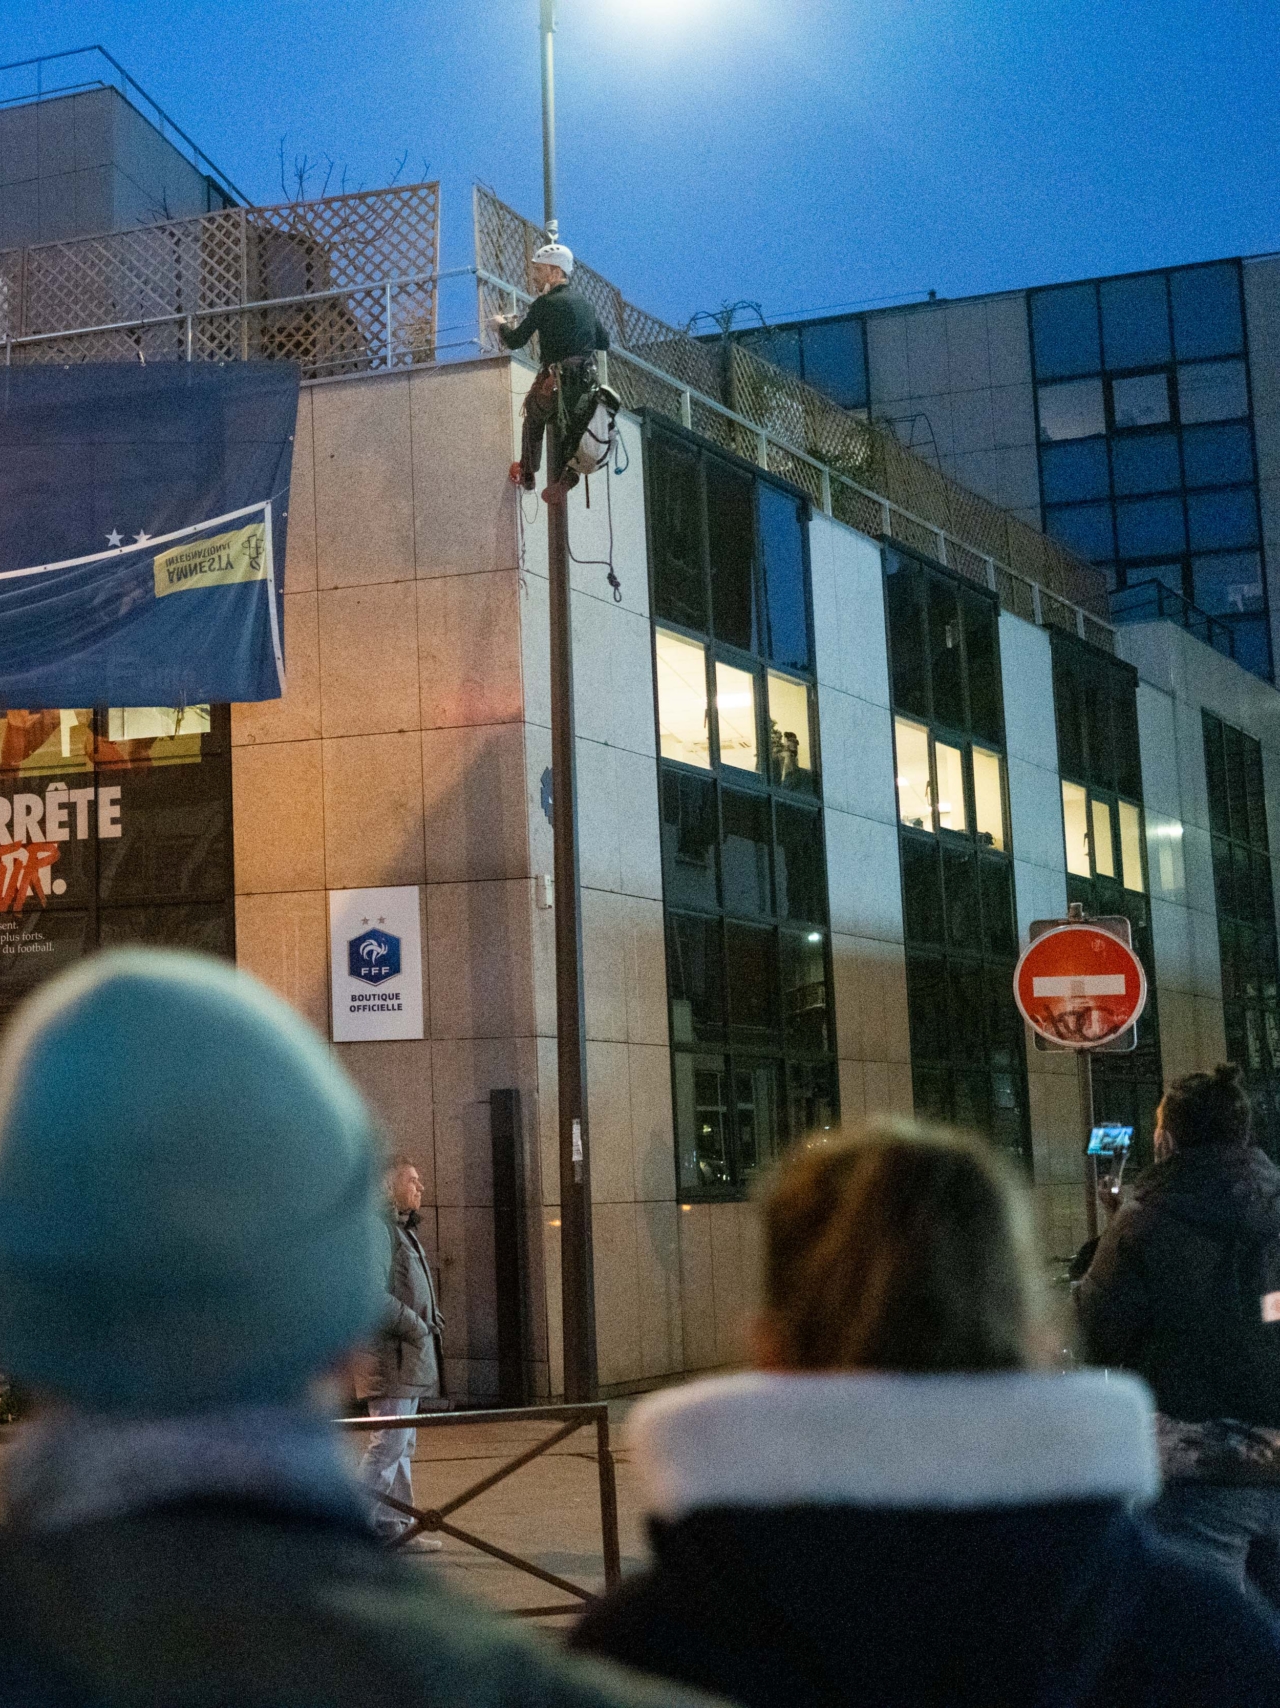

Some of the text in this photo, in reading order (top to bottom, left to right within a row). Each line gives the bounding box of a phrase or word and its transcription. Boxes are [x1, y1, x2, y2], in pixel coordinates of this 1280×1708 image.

[0, 932, 20, 945] plus
[22, 931, 46, 941] forts.
[2, 944, 15, 954] du
[18, 941, 55, 953] football.
[361, 966, 390, 976] FFF
[350, 992, 401, 1002] BOUTIQUE
[349, 1003, 403, 1013] OFFICIELLE
